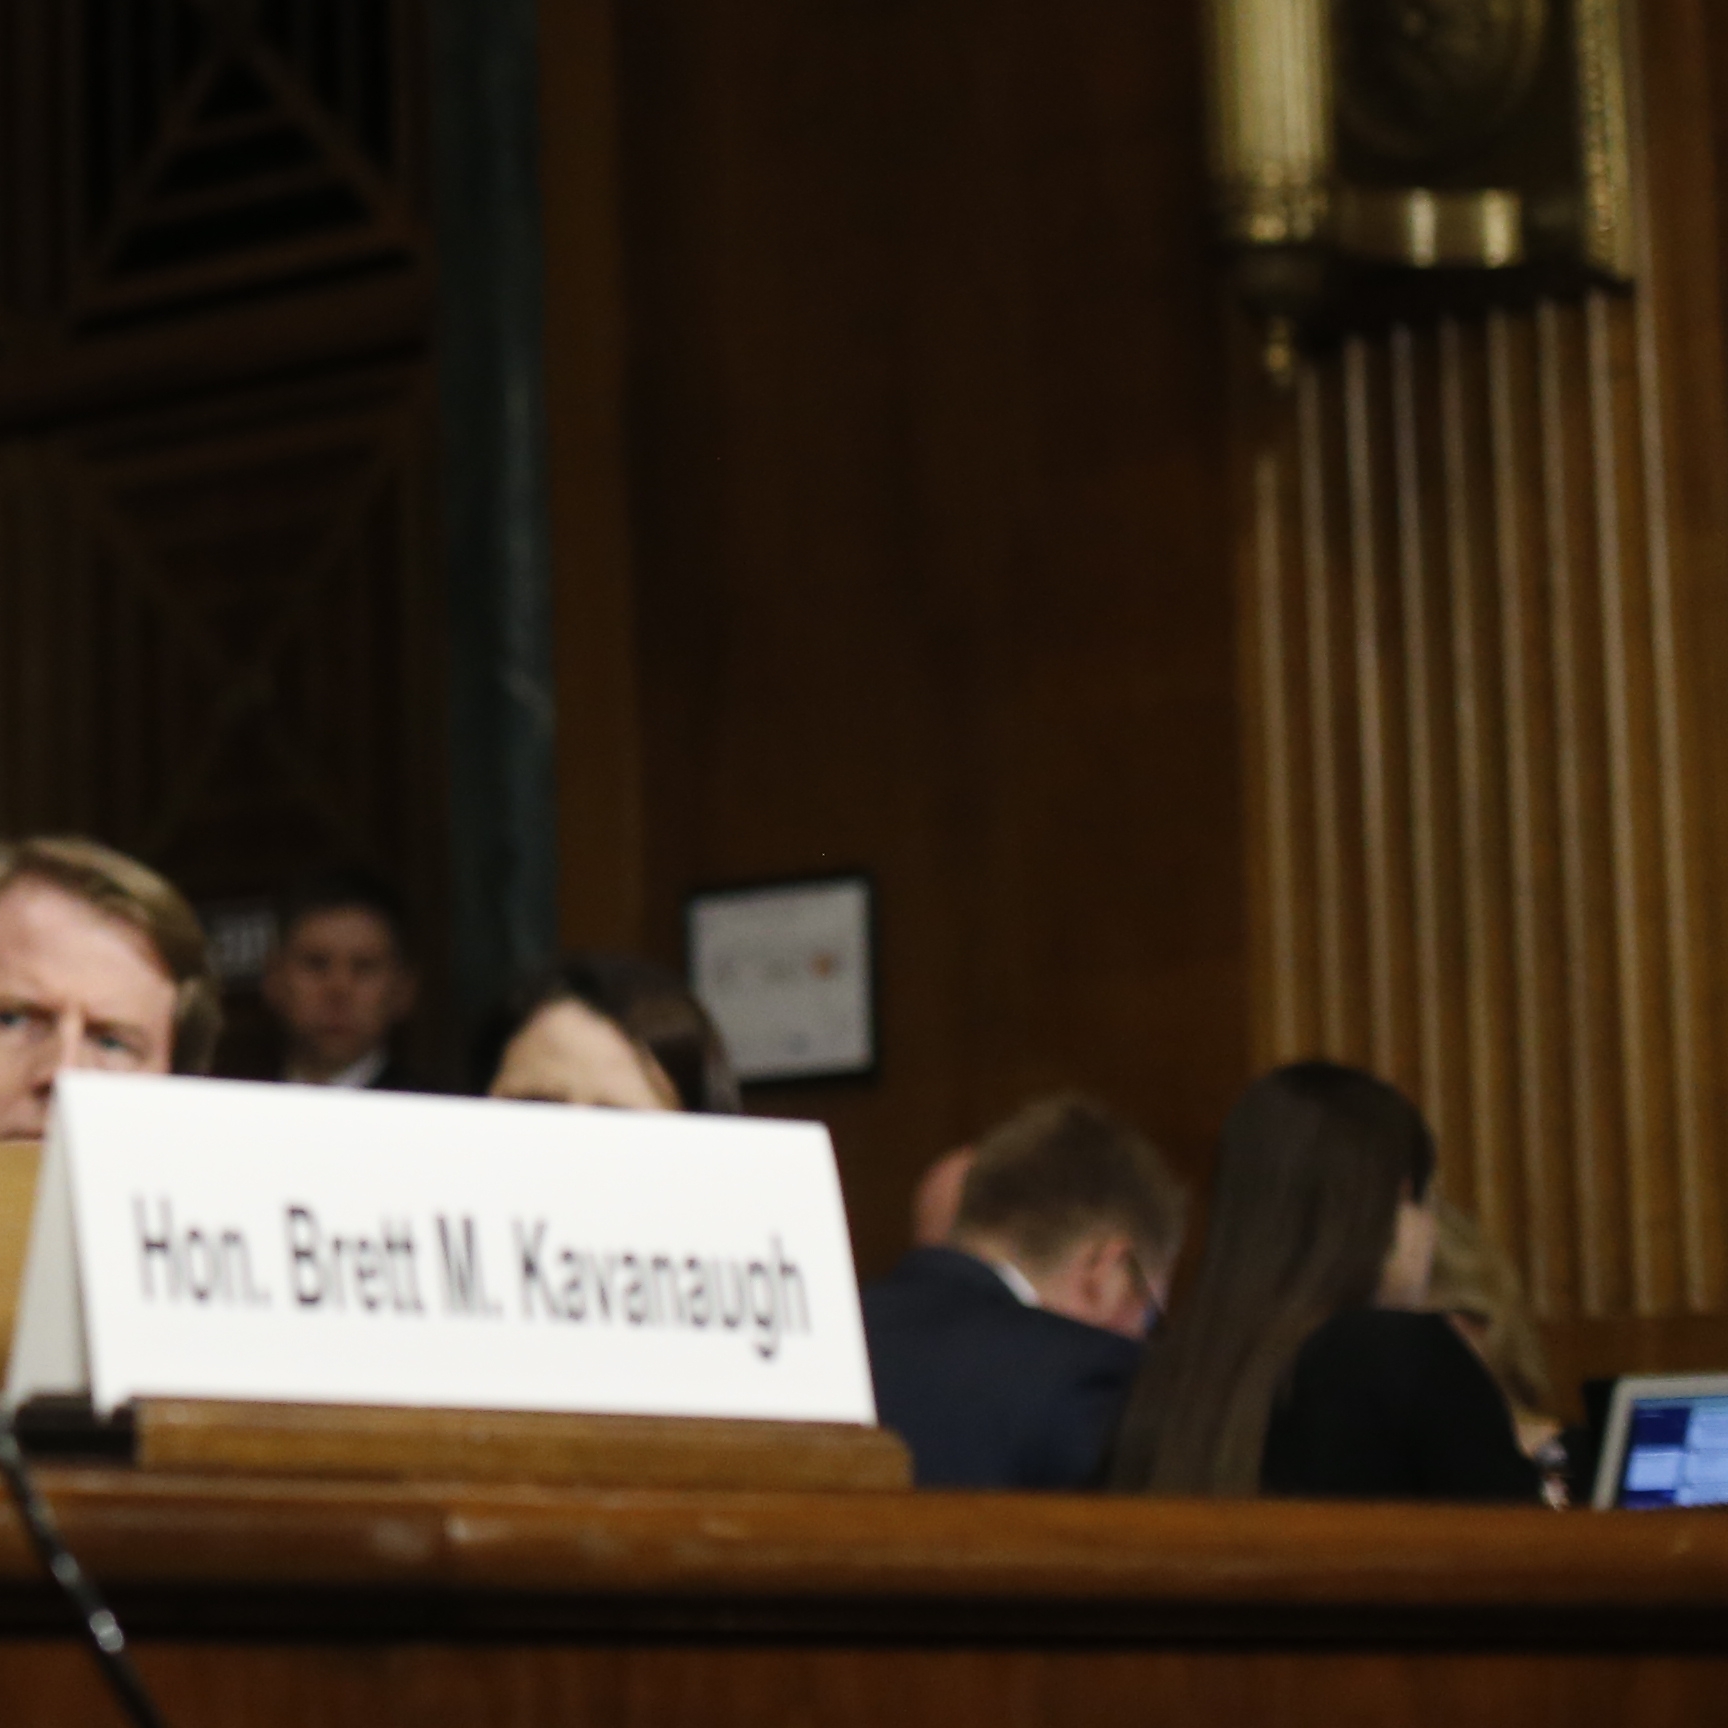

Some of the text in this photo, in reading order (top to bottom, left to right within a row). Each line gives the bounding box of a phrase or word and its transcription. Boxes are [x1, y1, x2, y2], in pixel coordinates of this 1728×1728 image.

[134, 1198, 811, 1362] Hon. Brett M. Kavanaugh
